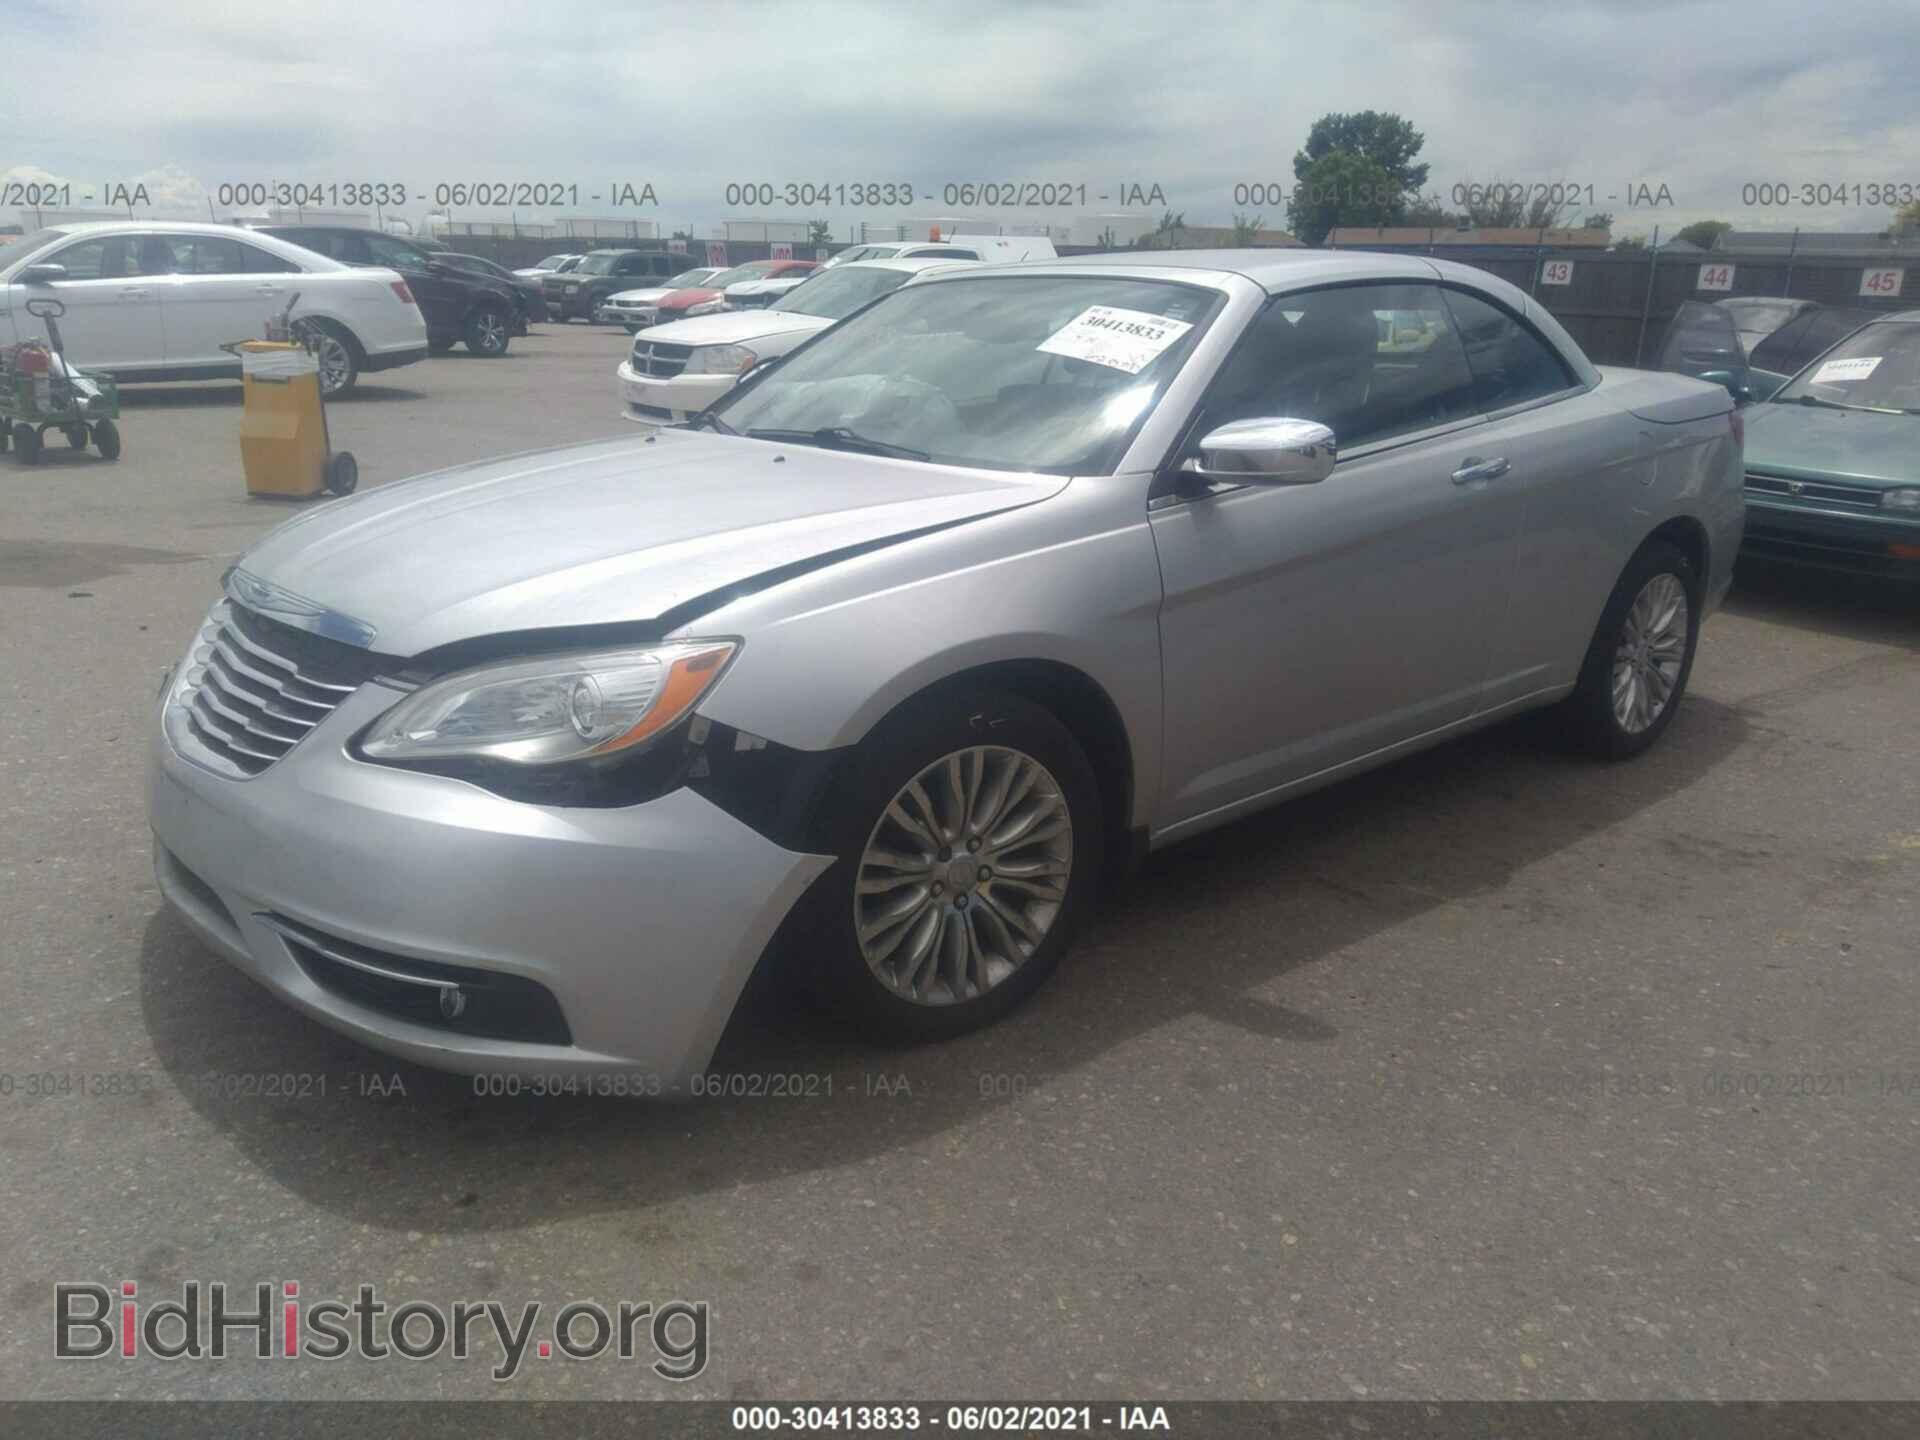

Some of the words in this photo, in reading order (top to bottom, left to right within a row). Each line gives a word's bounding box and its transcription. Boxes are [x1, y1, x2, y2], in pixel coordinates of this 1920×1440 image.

[1547, 264, 1568, 280] 43
[1704, 268, 1728, 287] 44
[1866, 272, 1896, 290] 45
[1080, 316, 1165, 340] 30413833
